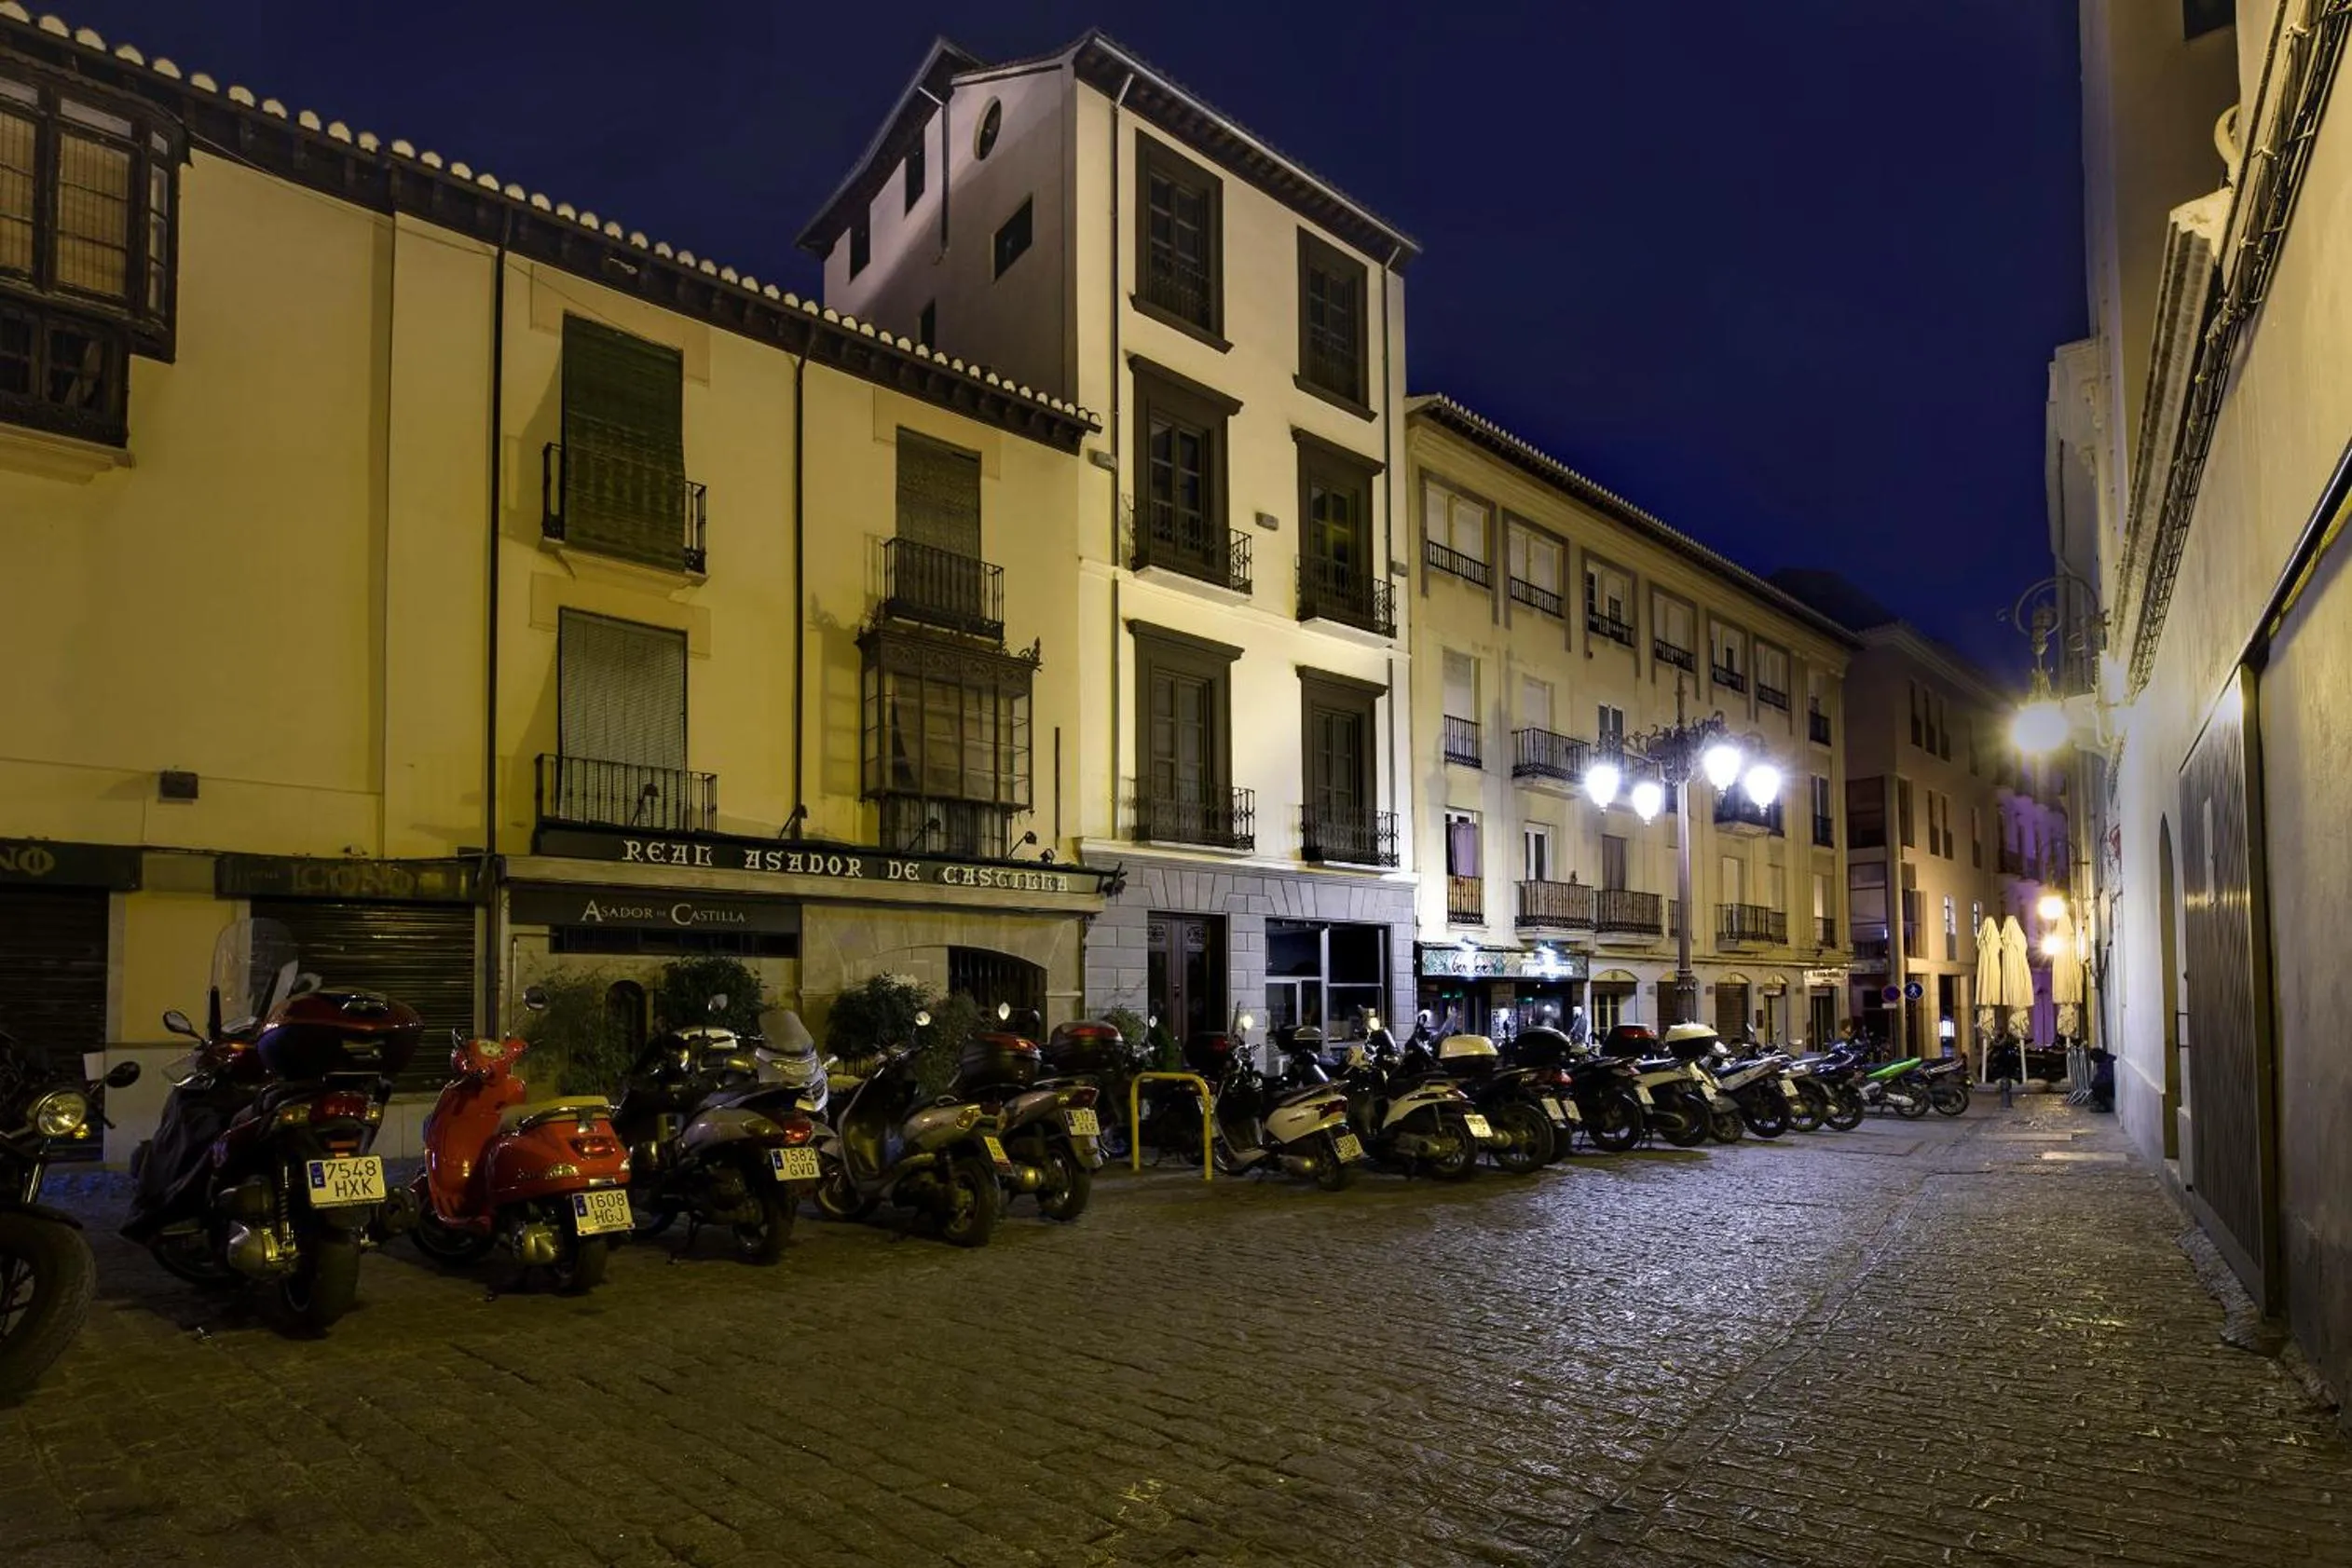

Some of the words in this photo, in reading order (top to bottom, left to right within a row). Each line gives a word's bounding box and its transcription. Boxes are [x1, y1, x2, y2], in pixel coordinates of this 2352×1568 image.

[622, 839, 714, 866] REAL
[744, 848, 863, 878] ASADOR
[887, 859, 920, 881] DE
[942, 866, 1069, 892] CASTILLA
[292, 863, 416, 896] ICONO
[783, 1148, 815, 1164] 1582
[324, 1160, 376, 1179] 7548
[335, 1178, 374, 1197] HXK
[588, 1193, 625, 1209] 1608
[594, 1207, 625, 1224] HGJ
